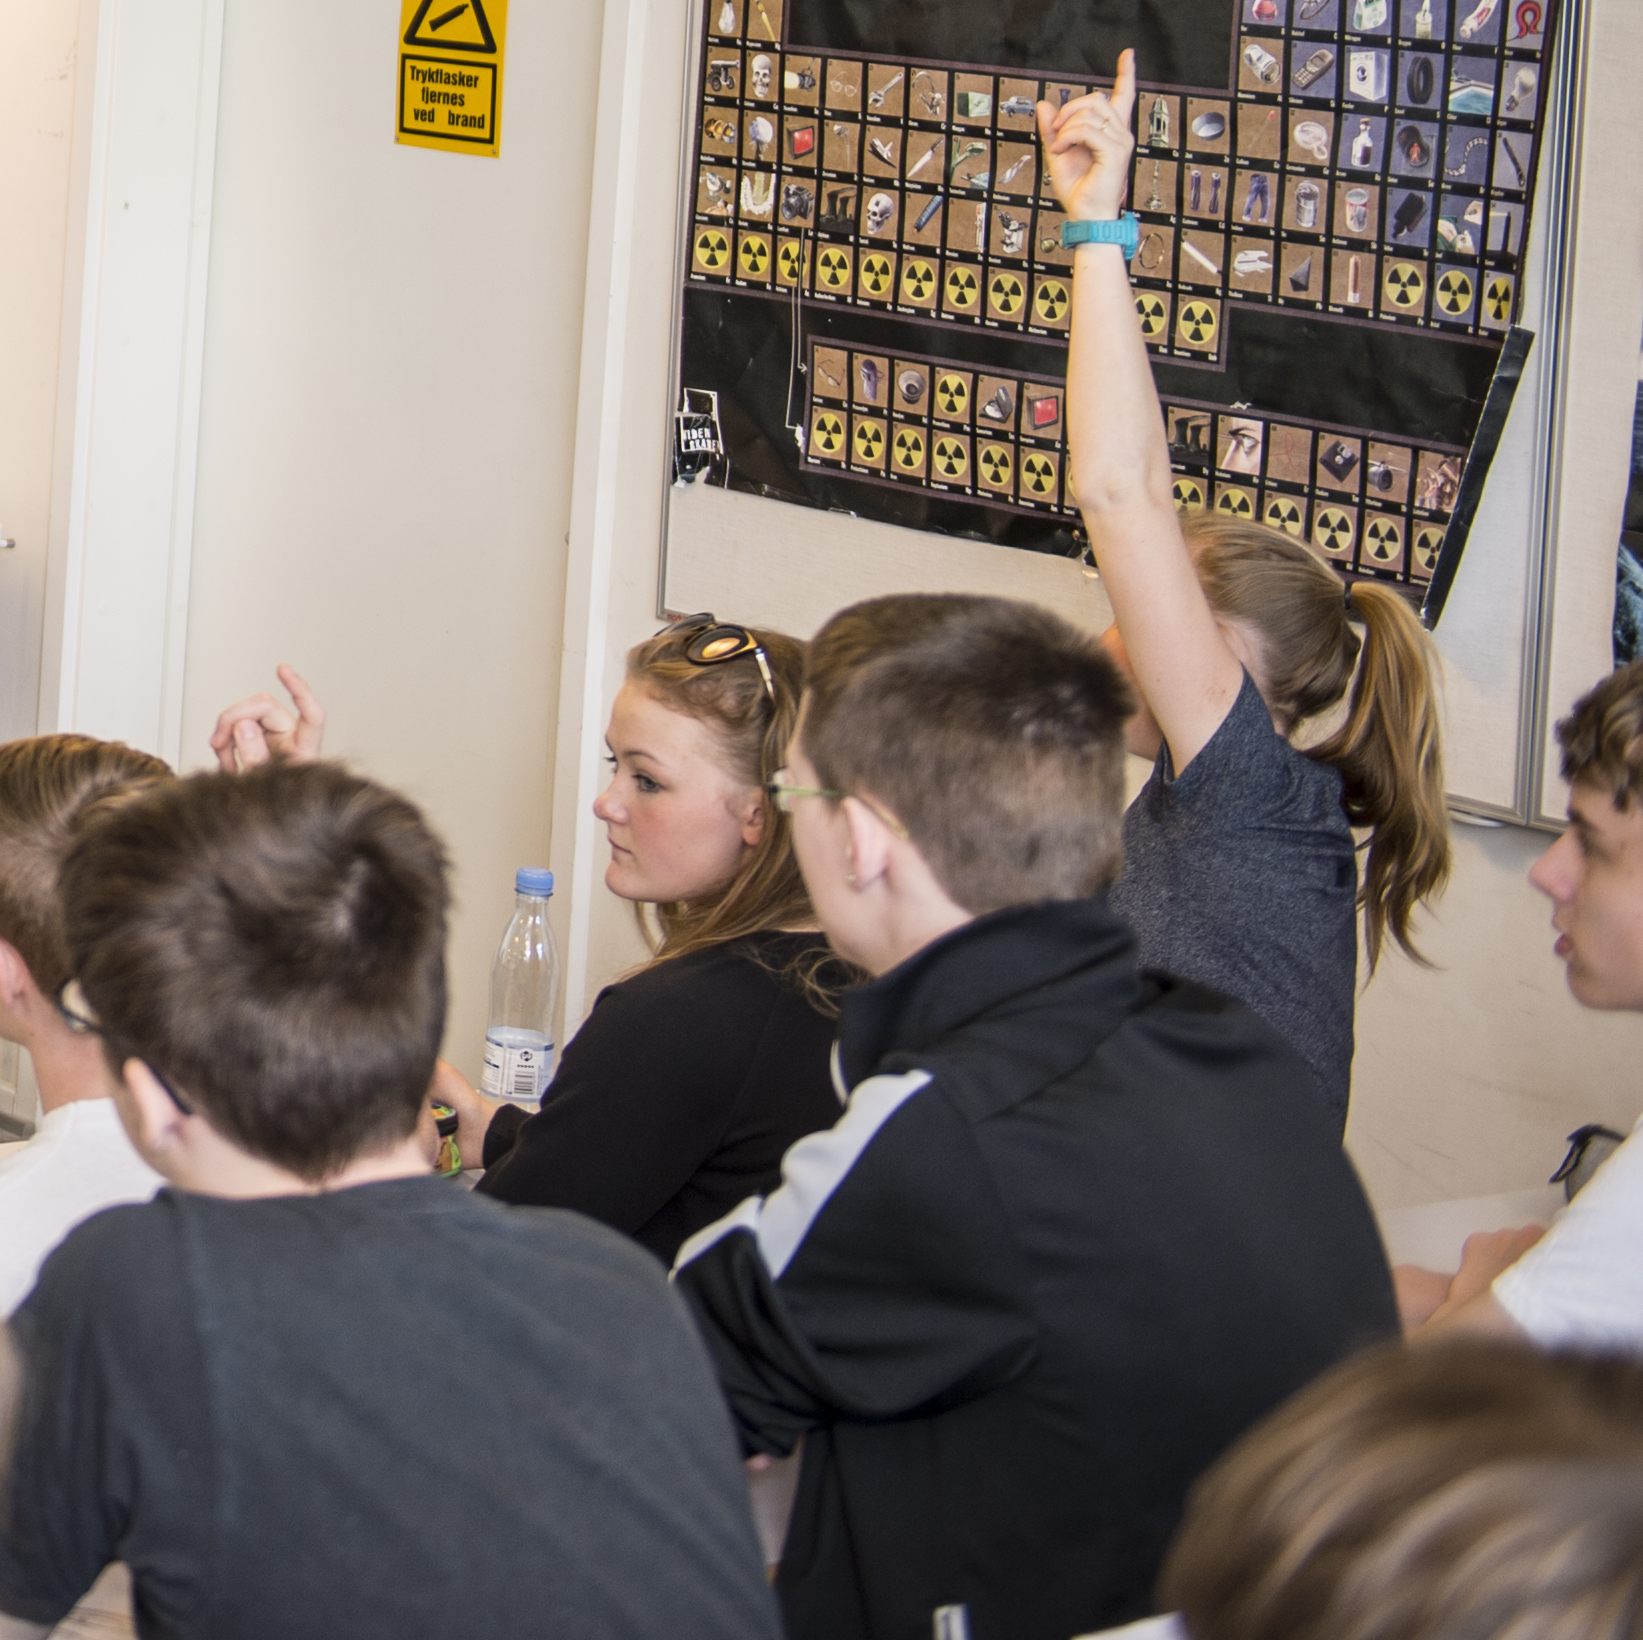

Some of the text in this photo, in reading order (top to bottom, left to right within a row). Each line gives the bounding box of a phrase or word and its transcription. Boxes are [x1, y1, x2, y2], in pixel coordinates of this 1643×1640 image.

[409, 65, 479, 88] Trykflasker
[421, 86, 465, 107] fjernes
[413, 108, 485, 130] ved brand
